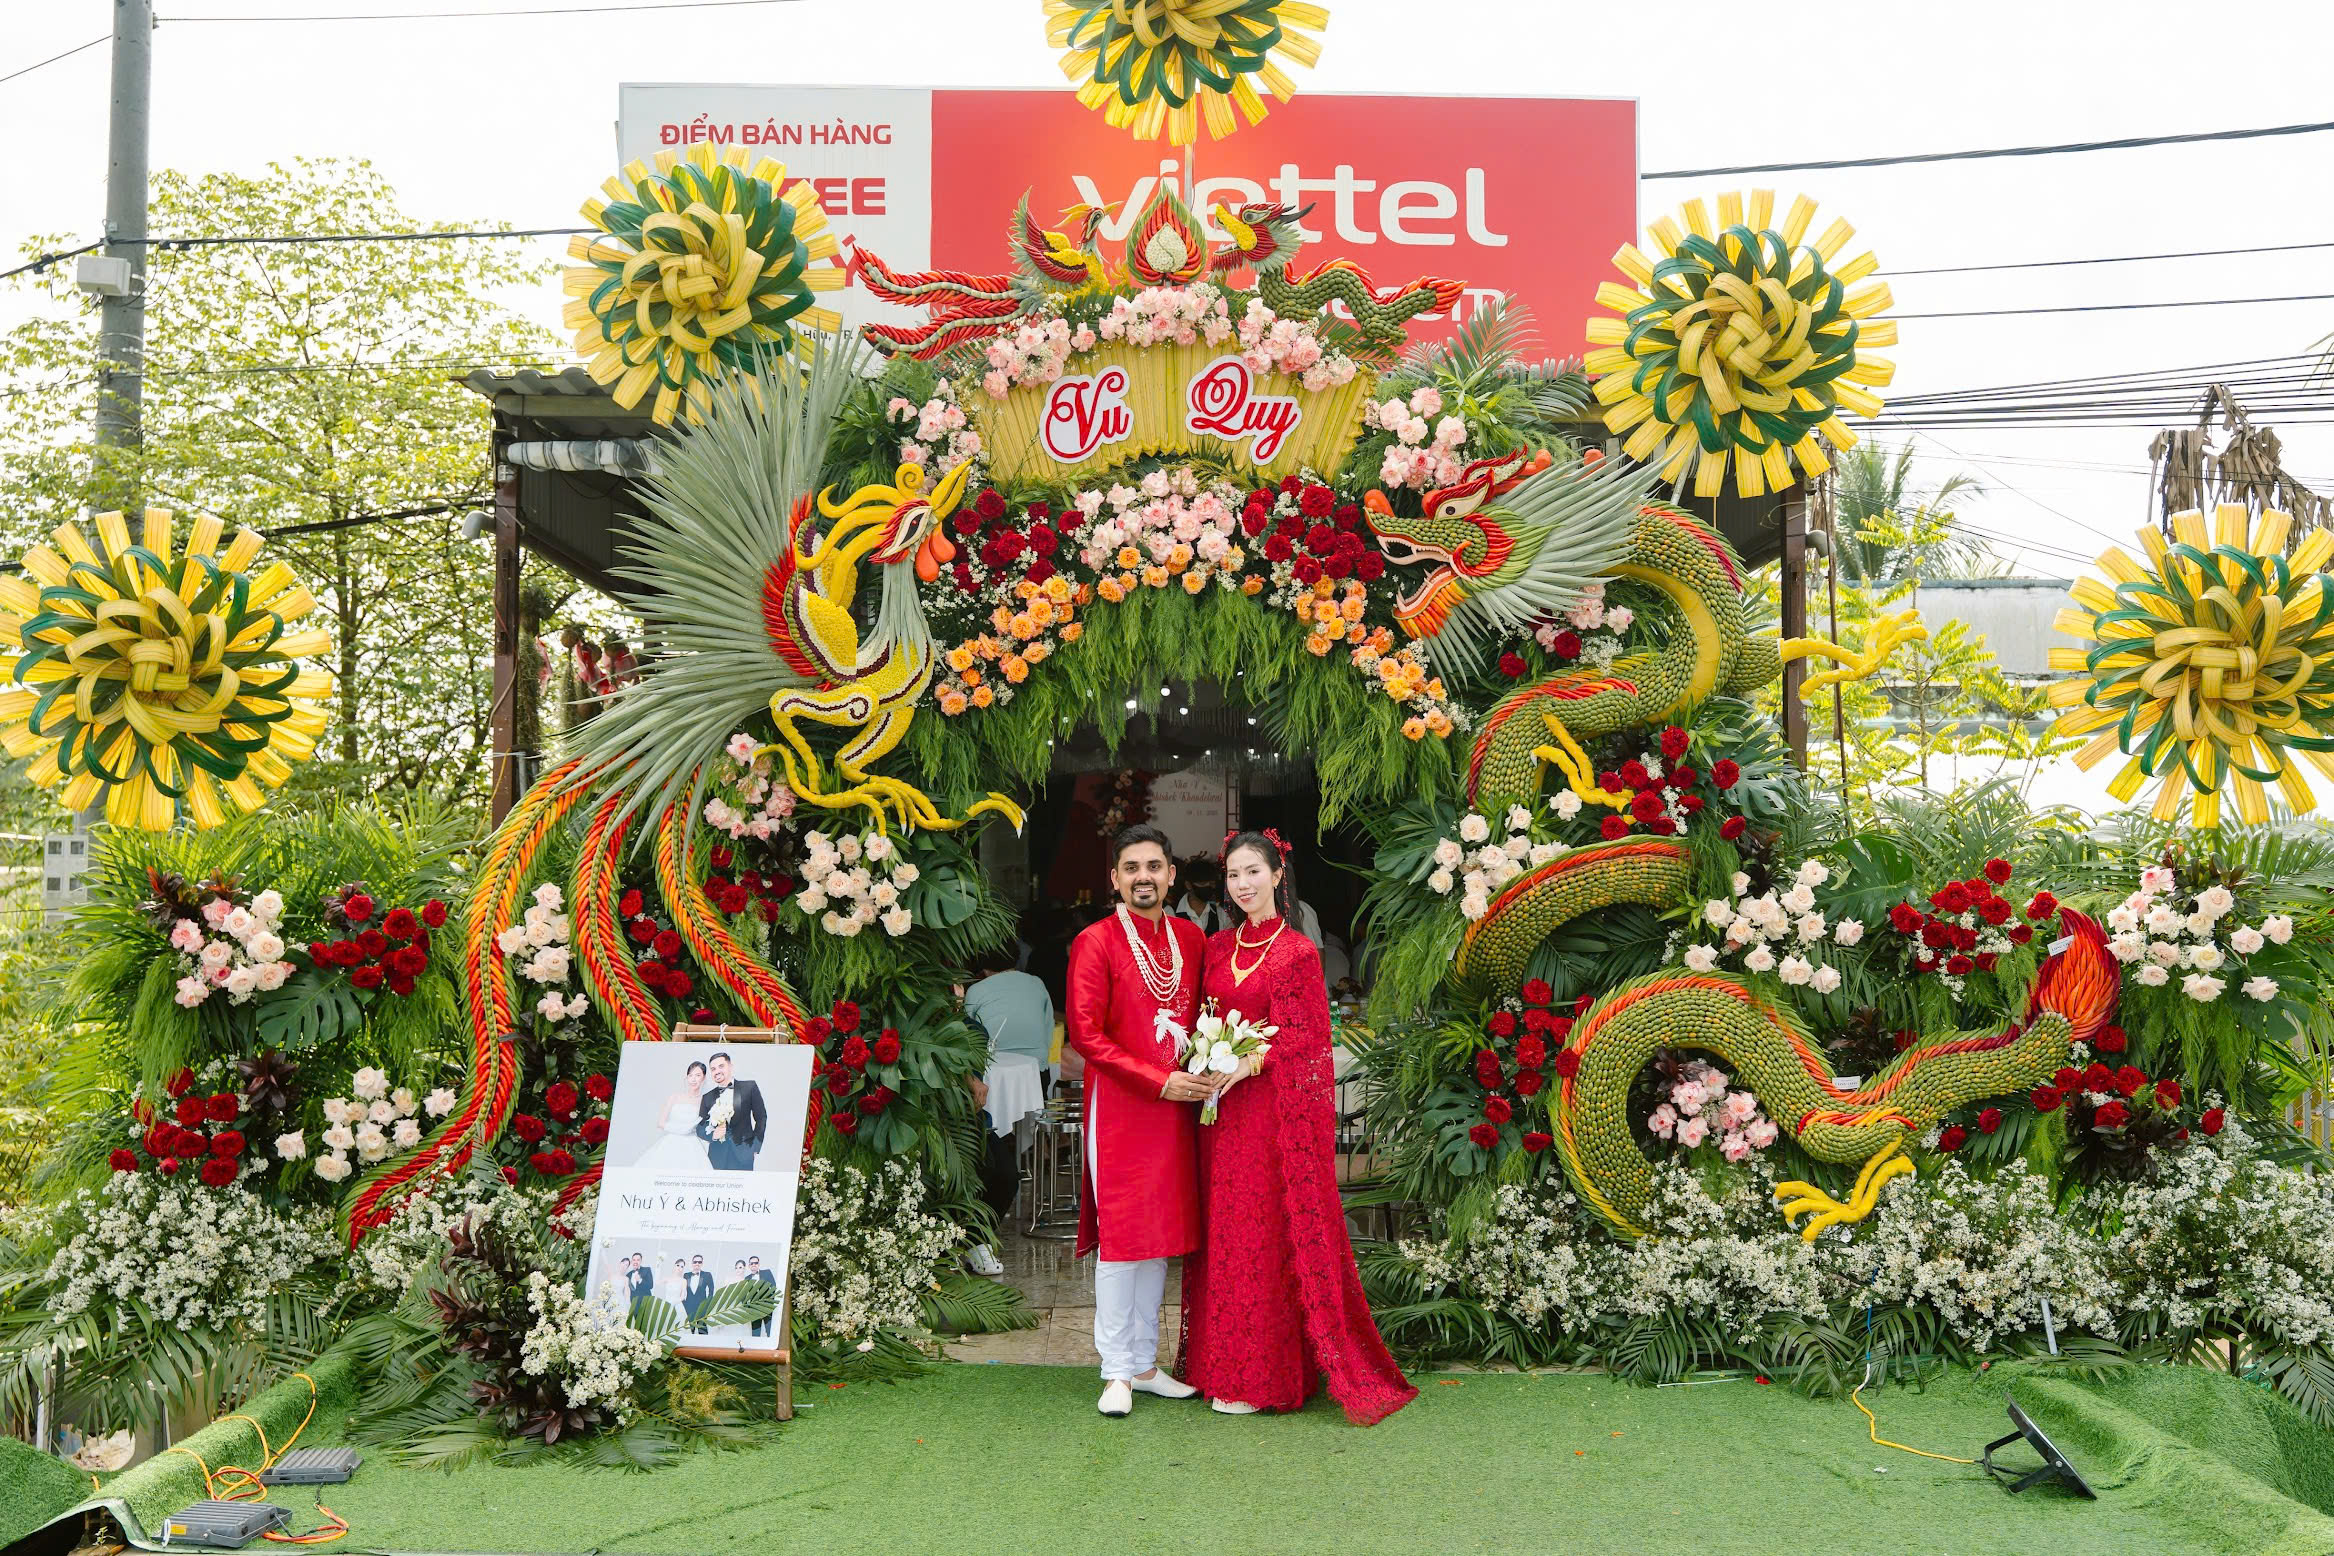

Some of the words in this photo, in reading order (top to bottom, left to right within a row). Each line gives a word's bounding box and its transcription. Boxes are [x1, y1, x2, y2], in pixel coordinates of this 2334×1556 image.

[660, 113, 734, 145] ĐIỂM
[742, 117, 801, 145] BÁN
[811, 117, 892, 145] HÀNG
[1045, 371, 1130, 459] Vu
[1190, 361, 1298, 460] Quy
[675, 1196, 686, 1211] &
[693, 1196, 772, 1214] Abhishek
